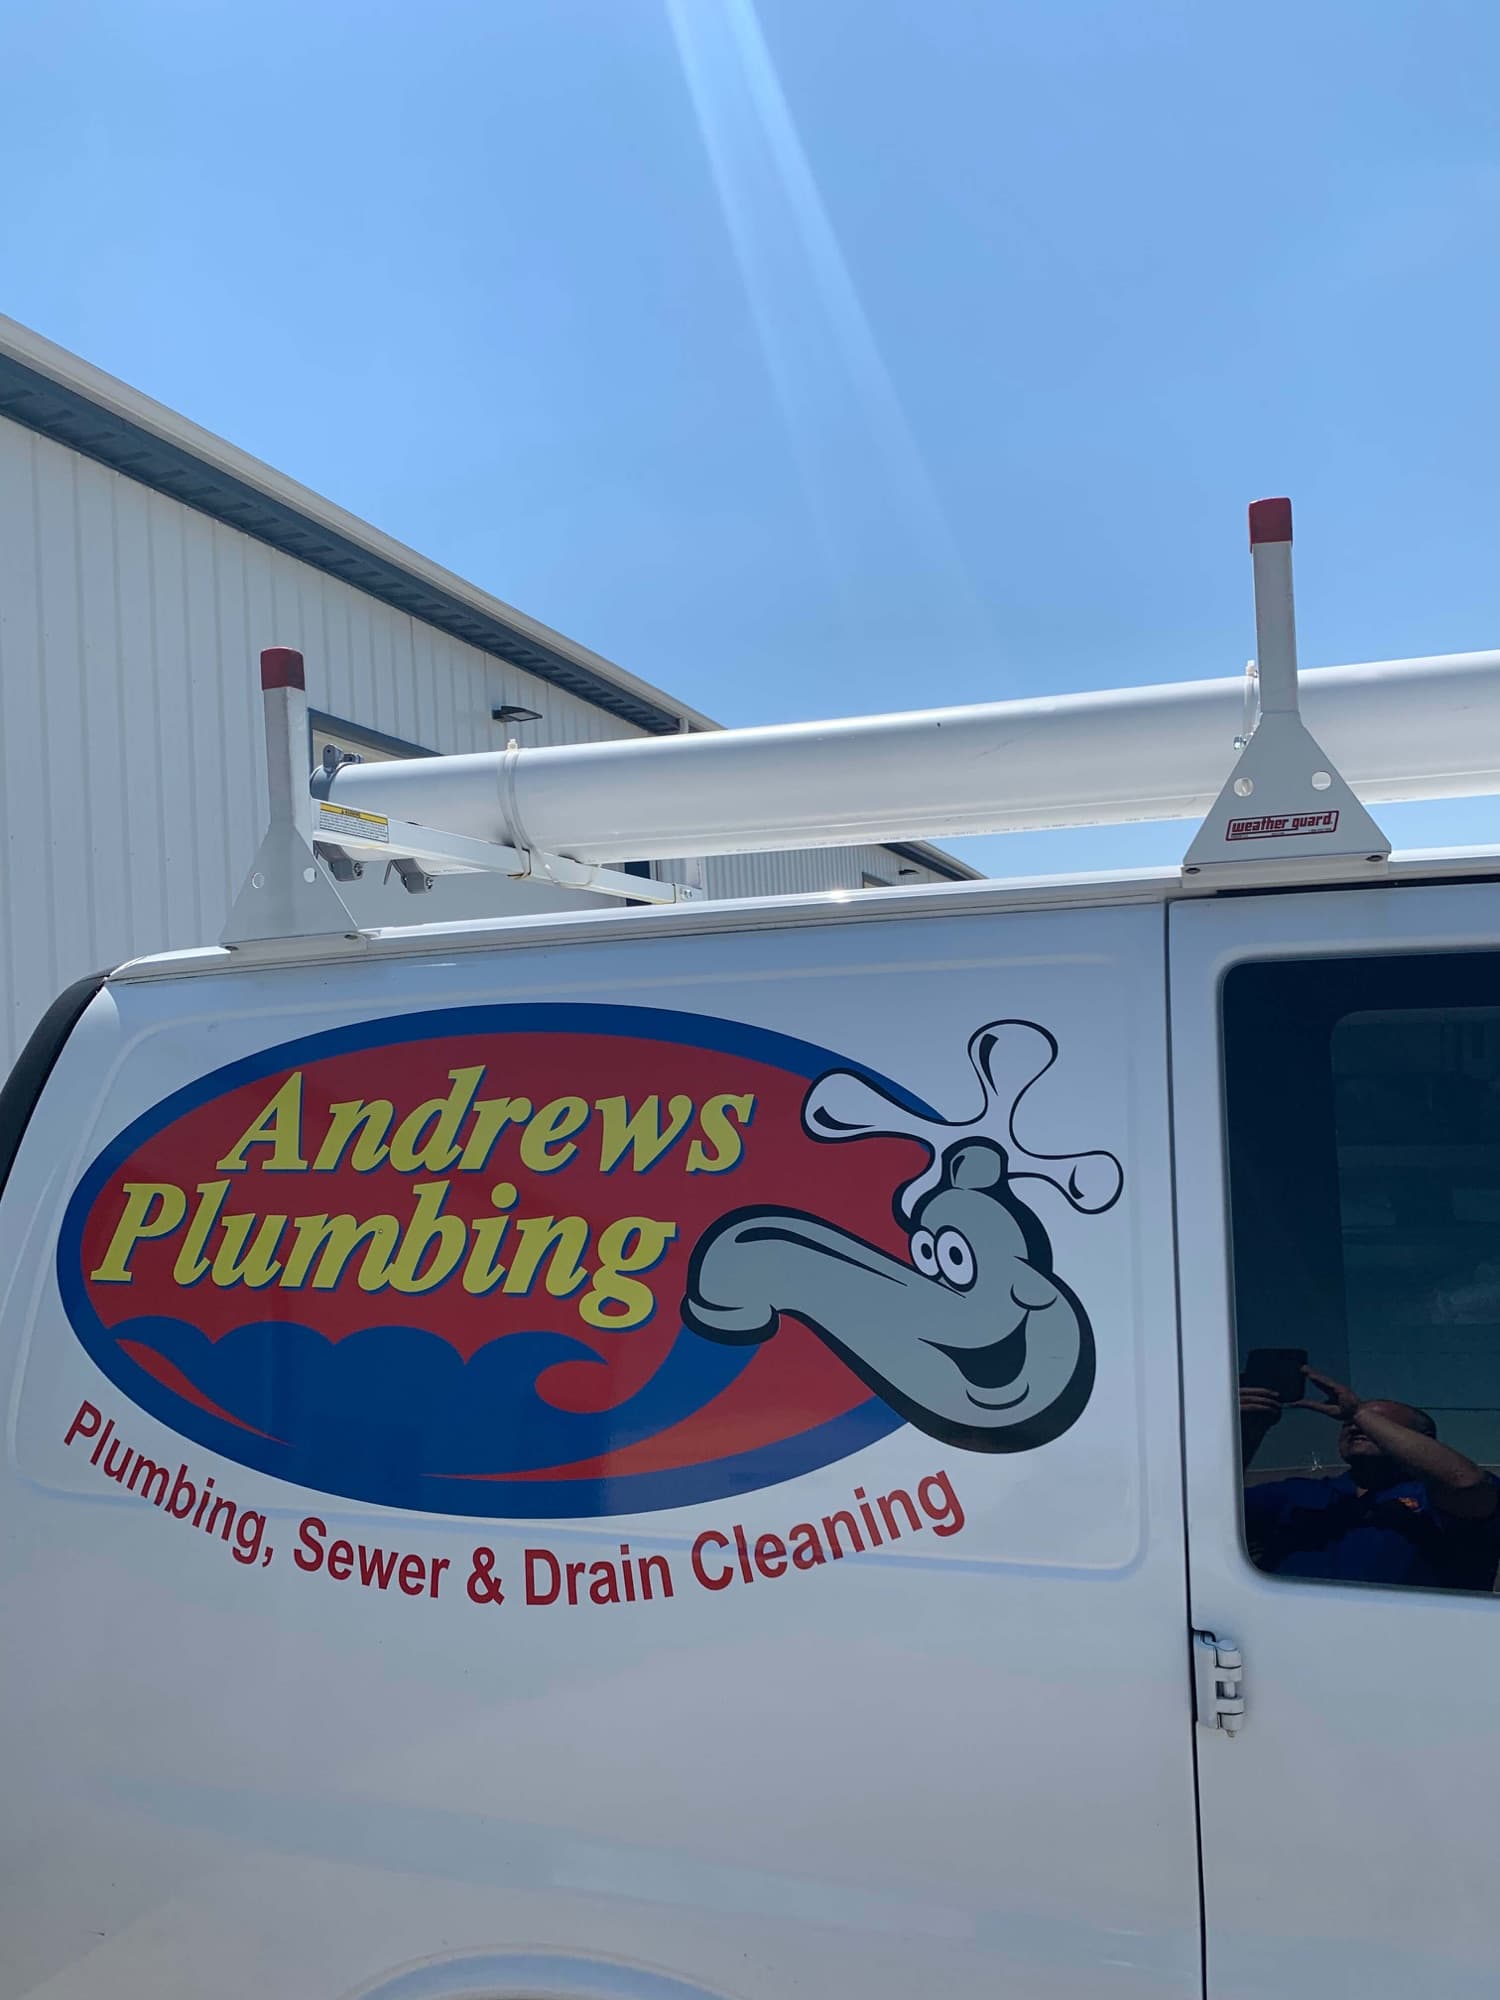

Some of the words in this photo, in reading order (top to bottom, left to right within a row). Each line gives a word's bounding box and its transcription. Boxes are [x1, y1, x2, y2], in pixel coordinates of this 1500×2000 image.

[1231, 817, 1290, 833] weather
[1291, 811, 1333, 829] guard
[215, 1064, 757, 1175] Andrews
[90, 1179, 677, 1331] Plumbing
[63, 1399, 274, 1568] Plumbing,
[293, 1516, 450, 1599] Sewer
[466, 1546, 505, 1606] &
[524, 1543, 675, 1606] Drain
[690, 1469, 966, 1592] Cleaning
